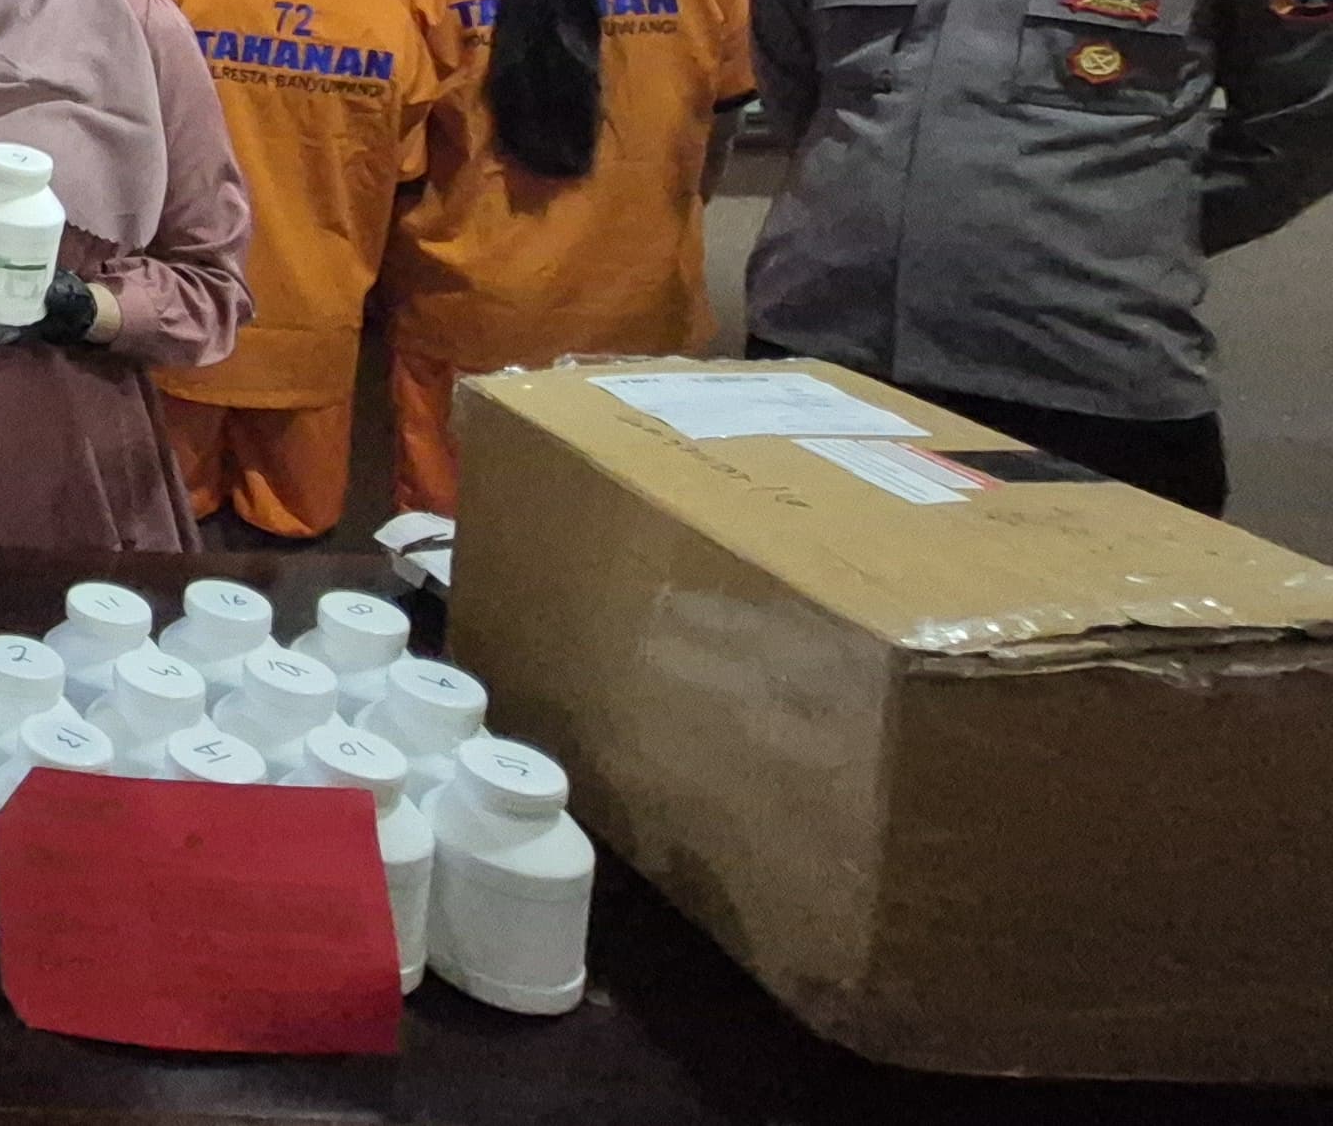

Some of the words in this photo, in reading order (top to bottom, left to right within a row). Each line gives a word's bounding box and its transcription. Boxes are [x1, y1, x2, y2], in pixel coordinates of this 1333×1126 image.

[274, 1, 315, 37] 72
[195, 29, 395, 81] TAHANAN
[211, 64, 269, 85] LRESTA
[7, 645, 33, 662] 2
